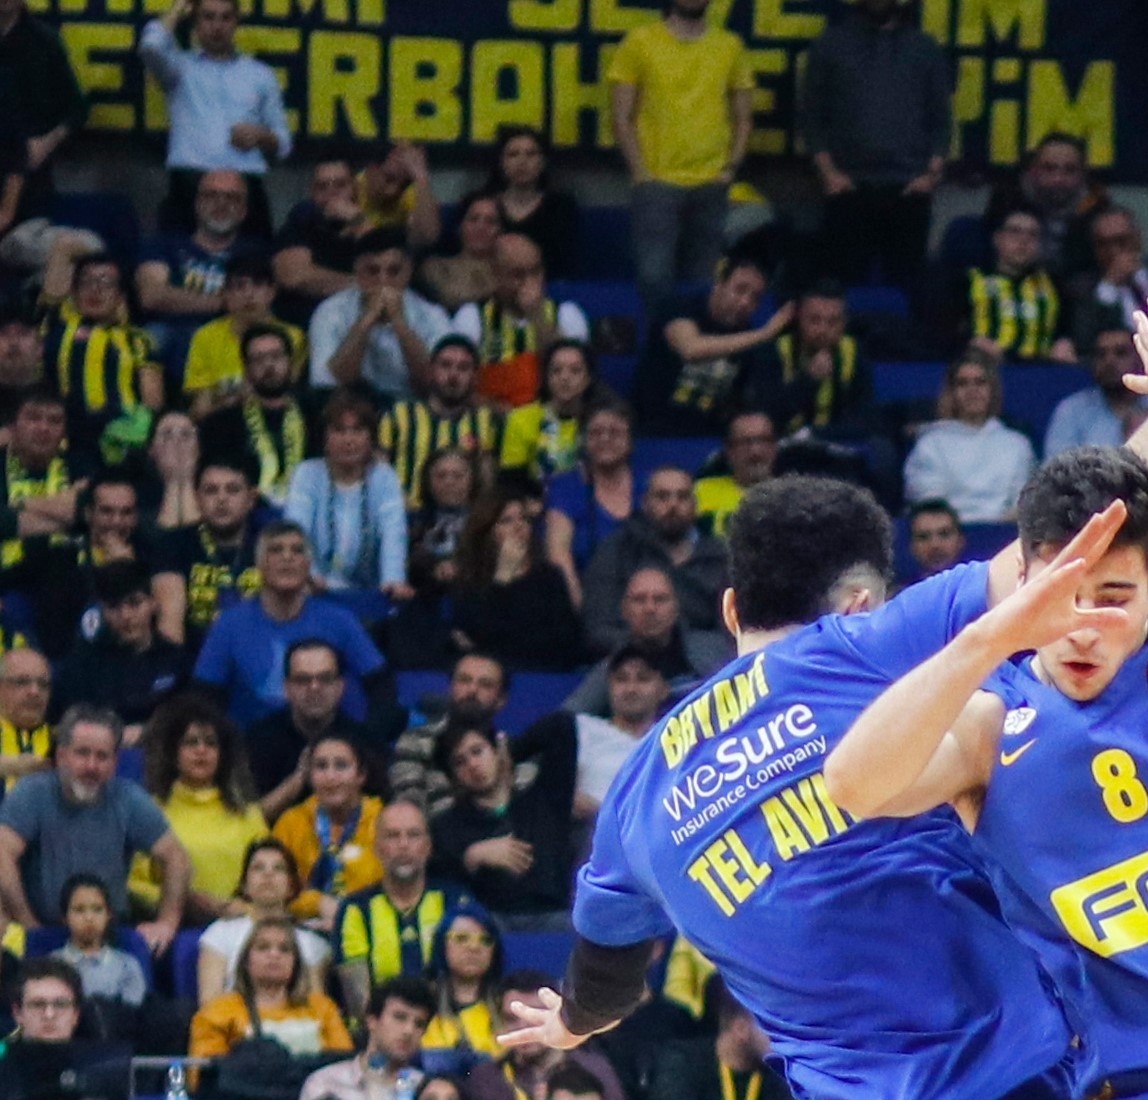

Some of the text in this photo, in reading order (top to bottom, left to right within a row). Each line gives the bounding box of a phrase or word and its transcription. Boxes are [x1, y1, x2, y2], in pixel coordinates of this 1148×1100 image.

[660, 652, 769, 770] BRYANT
[671, 735, 827, 846] Insurance Company
[687, 773, 863, 918] TEL AVI
